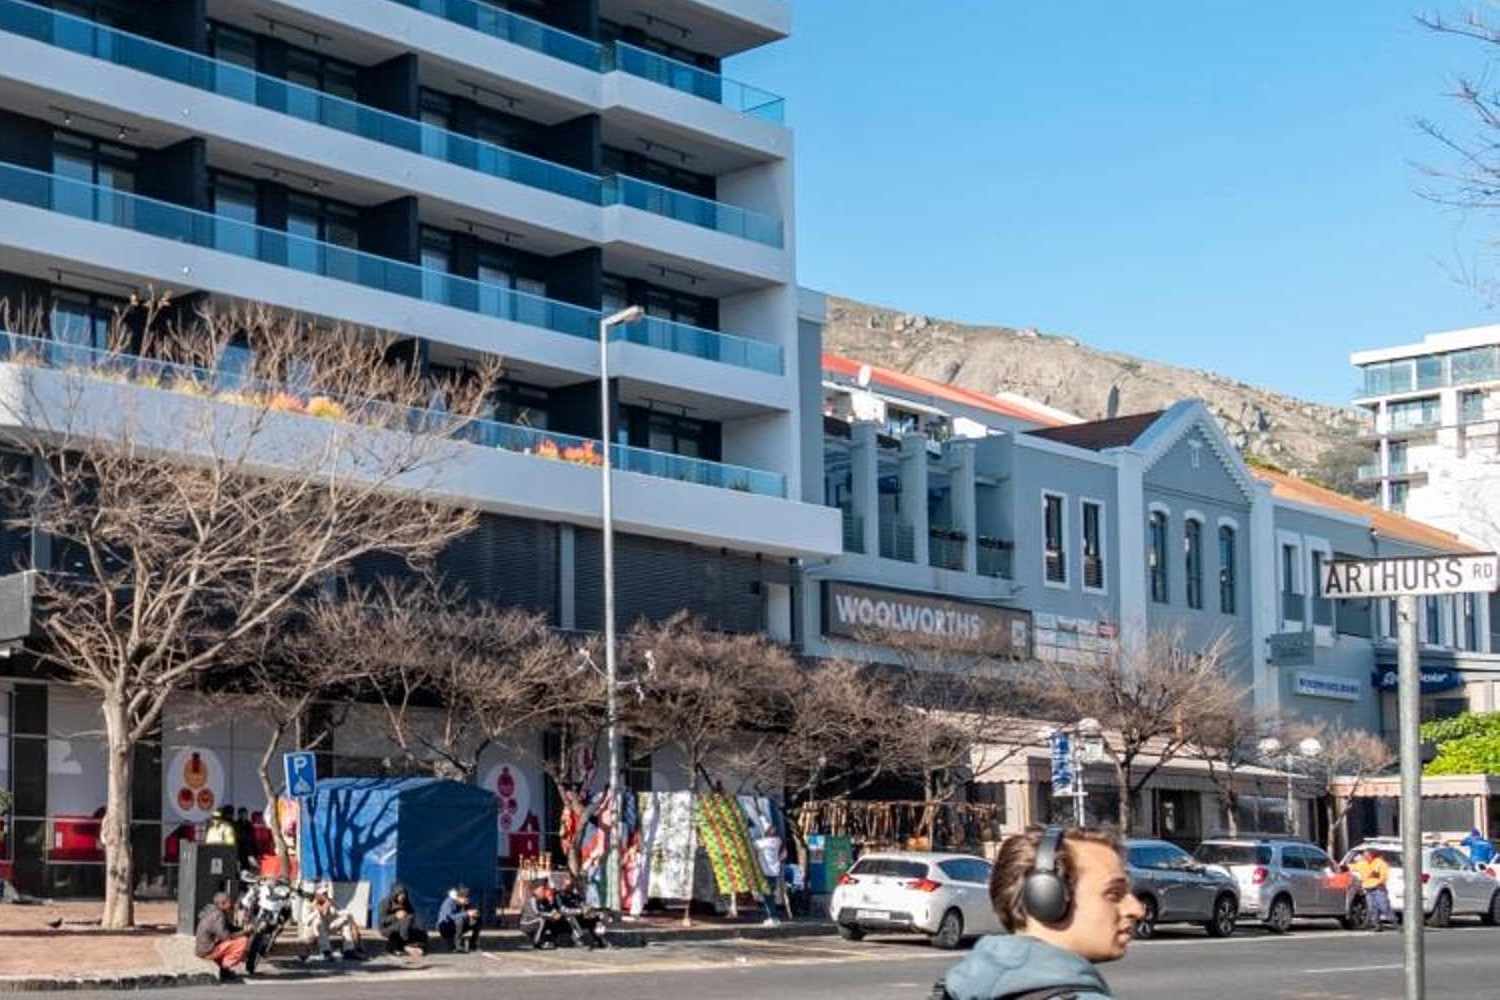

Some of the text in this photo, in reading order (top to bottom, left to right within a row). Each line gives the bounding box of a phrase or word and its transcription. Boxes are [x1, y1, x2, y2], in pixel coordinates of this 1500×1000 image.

[1325, 557, 1493, 594] ARTHURS RD
[835, 594, 981, 641] WOOLWORTHS
[293, 755, 308, 775] P
